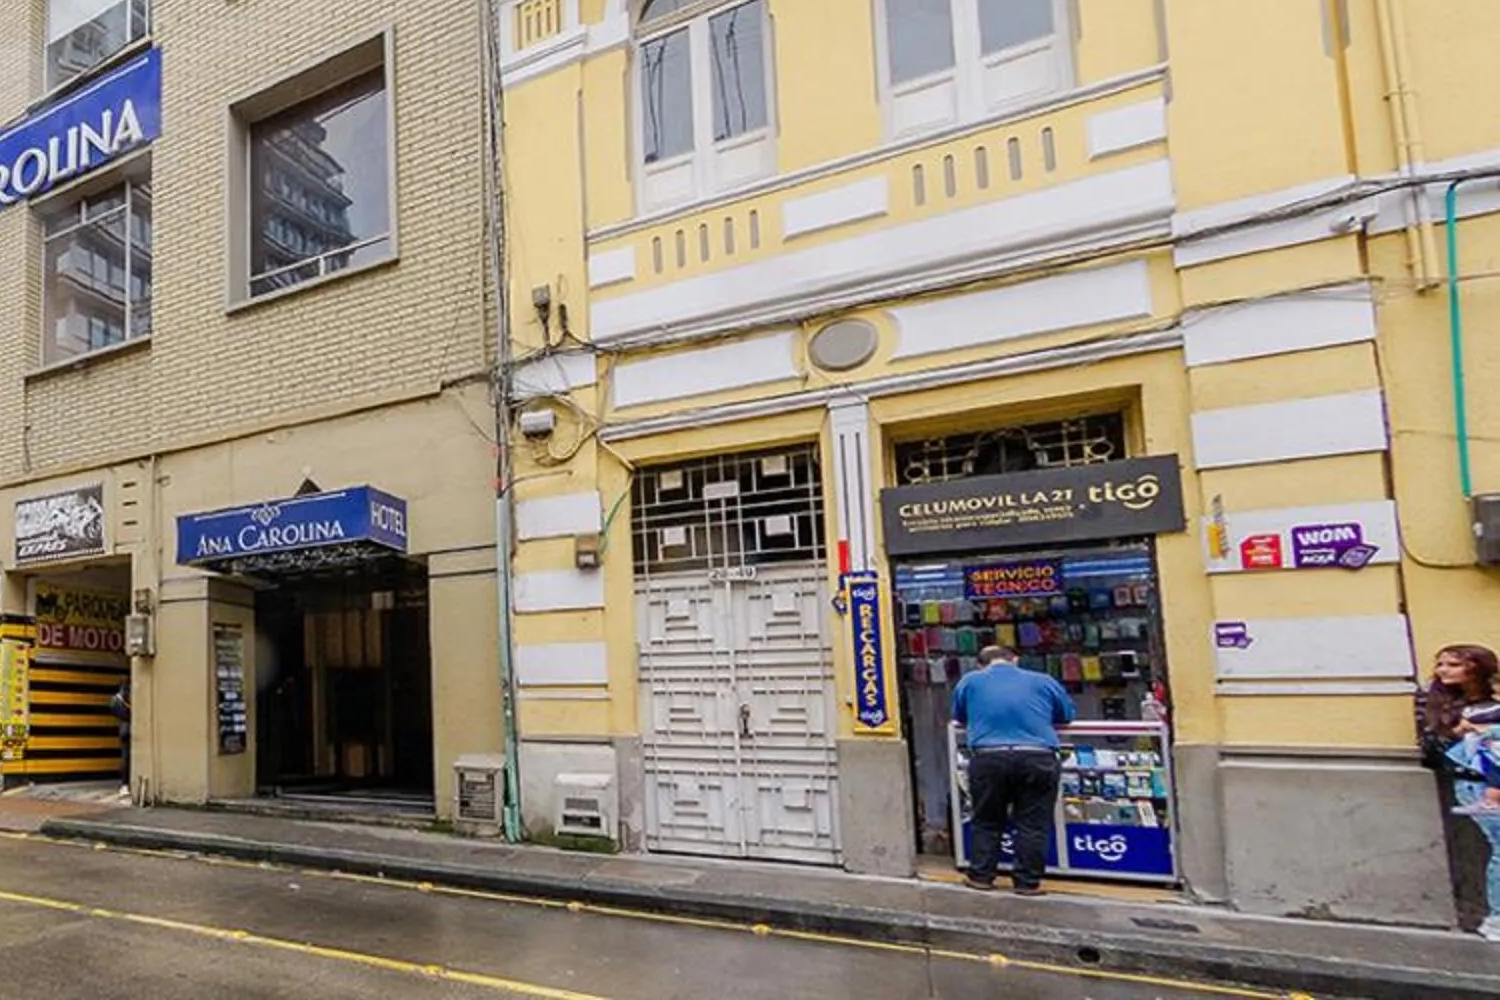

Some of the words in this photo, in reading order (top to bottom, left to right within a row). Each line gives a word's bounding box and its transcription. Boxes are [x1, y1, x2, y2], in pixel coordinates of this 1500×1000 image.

[900, 493, 1016, 518] CELUMOVIL
[371, 501, 406, 537] HOTEL
[196, 535, 233, 556] ANA
[238, 520, 344, 550] CAROLINA
[1297, 527, 1357, 546] WOM
[971, 566, 1055, 582] SERVICIO
[38, 623, 64, 646] DE
[859, 604, 878, 706] RECARGAS
[1074, 835, 1128, 861] tigo
